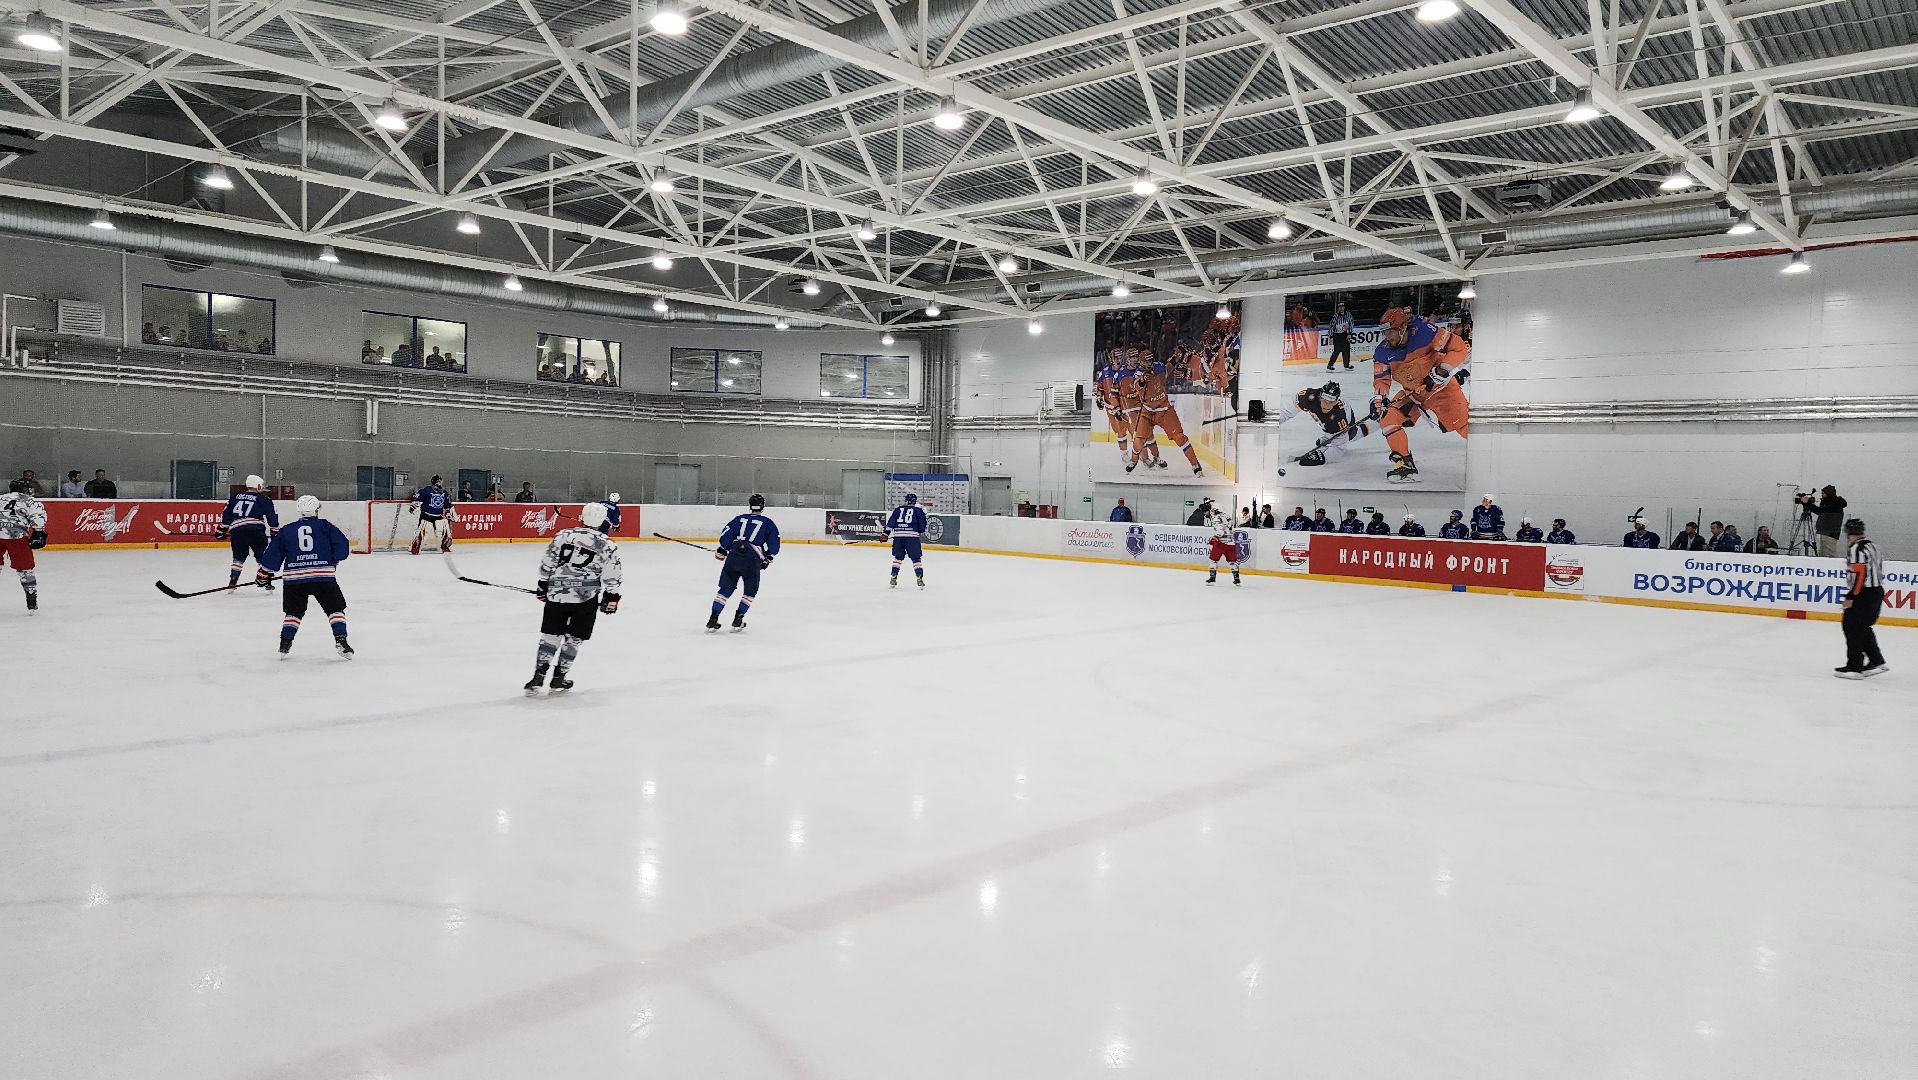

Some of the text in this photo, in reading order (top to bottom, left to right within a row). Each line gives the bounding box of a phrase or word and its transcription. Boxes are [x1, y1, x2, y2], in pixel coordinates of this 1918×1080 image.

[232, 500, 255, 517] 47
[896, 507, 915, 524] 18
[166, 513, 223, 524] НАРОДНЫ
[465, 522, 494, 532] ФРОНТ
[179, 523, 218, 534] ФРОНТ
[736, 517, 763, 543] 17
[297, 525, 314, 552] 6
[1154, 533, 1193, 544] ФЕДЕРАЦИЯ
[1148, 544, 1193, 555] МОСКОВСКОЙ
[1339, 548, 1510, 575] НАРОДНЫЙ ФРОНТ
[1684, 558, 1918, 586] благотворительны онд
[1633, 573, 1851, 605] ВОЗРОЖДЕНИЕ
